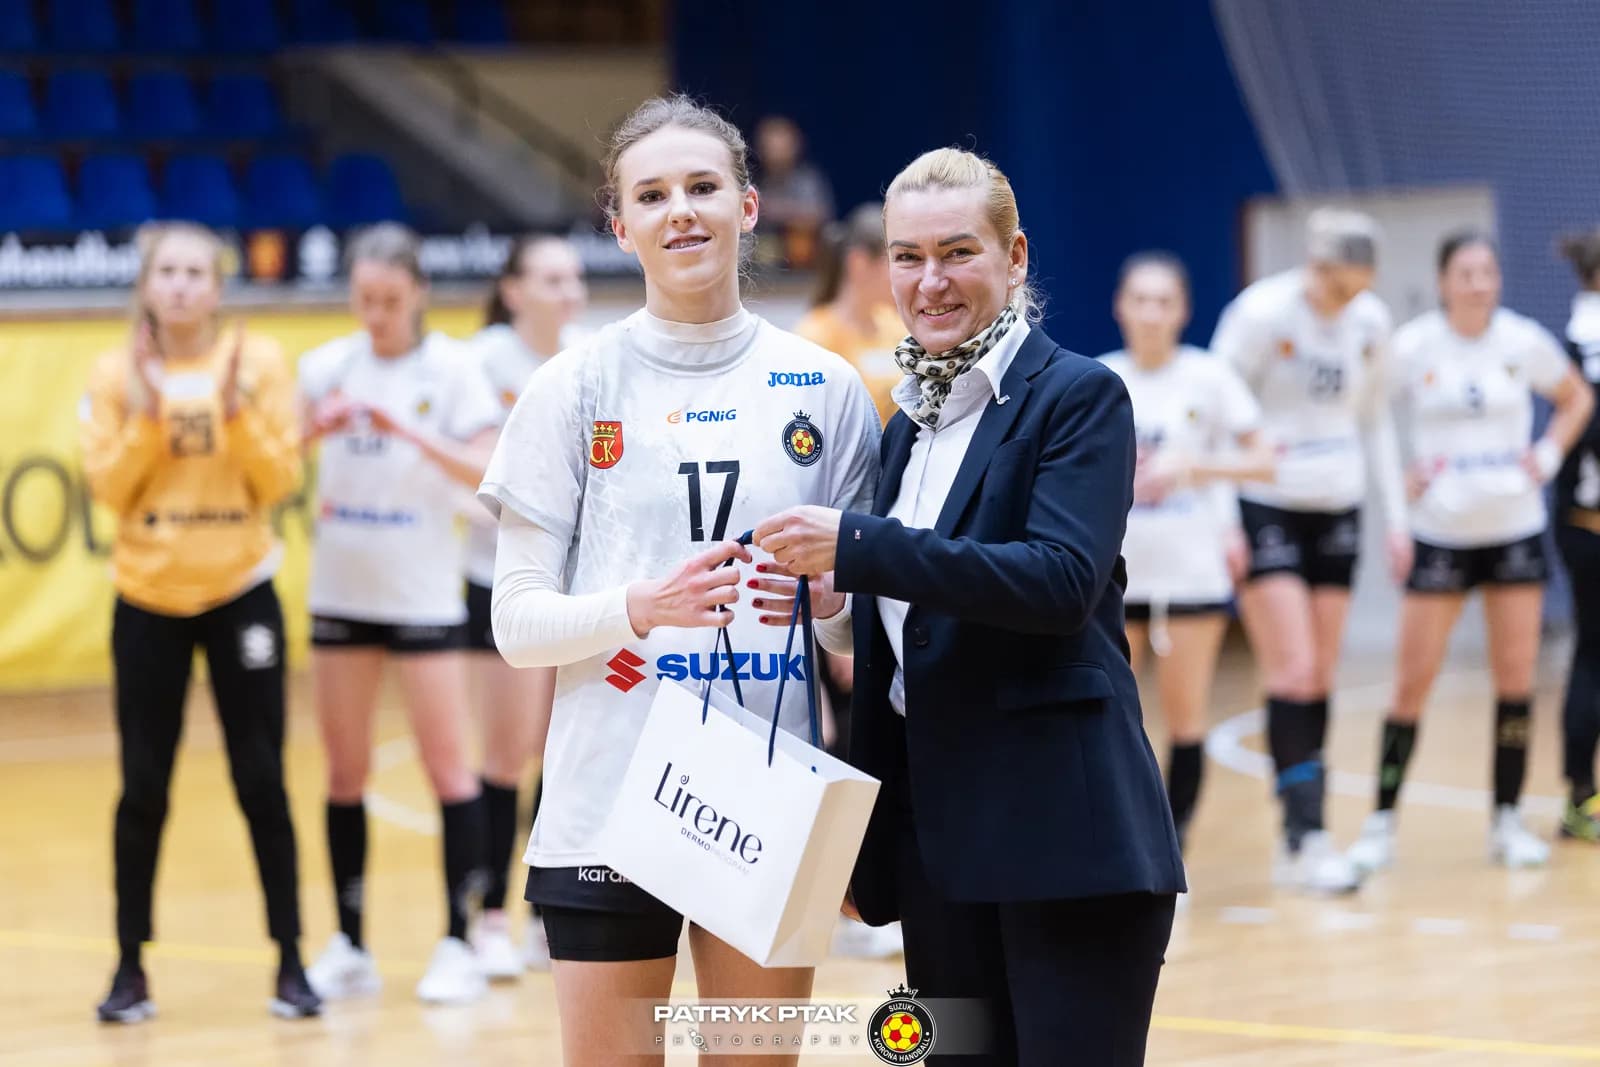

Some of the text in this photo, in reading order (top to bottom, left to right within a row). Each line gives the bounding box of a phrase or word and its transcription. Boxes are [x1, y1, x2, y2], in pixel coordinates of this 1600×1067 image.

[685, 408, 737, 423] PGNiG
[590, 439, 617, 464] CK
[678, 460, 740, 542] 17
[656, 652, 807, 681] SUZUK
[653, 761, 763, 865] Lirene
[577, 866, 631, 884] kara
